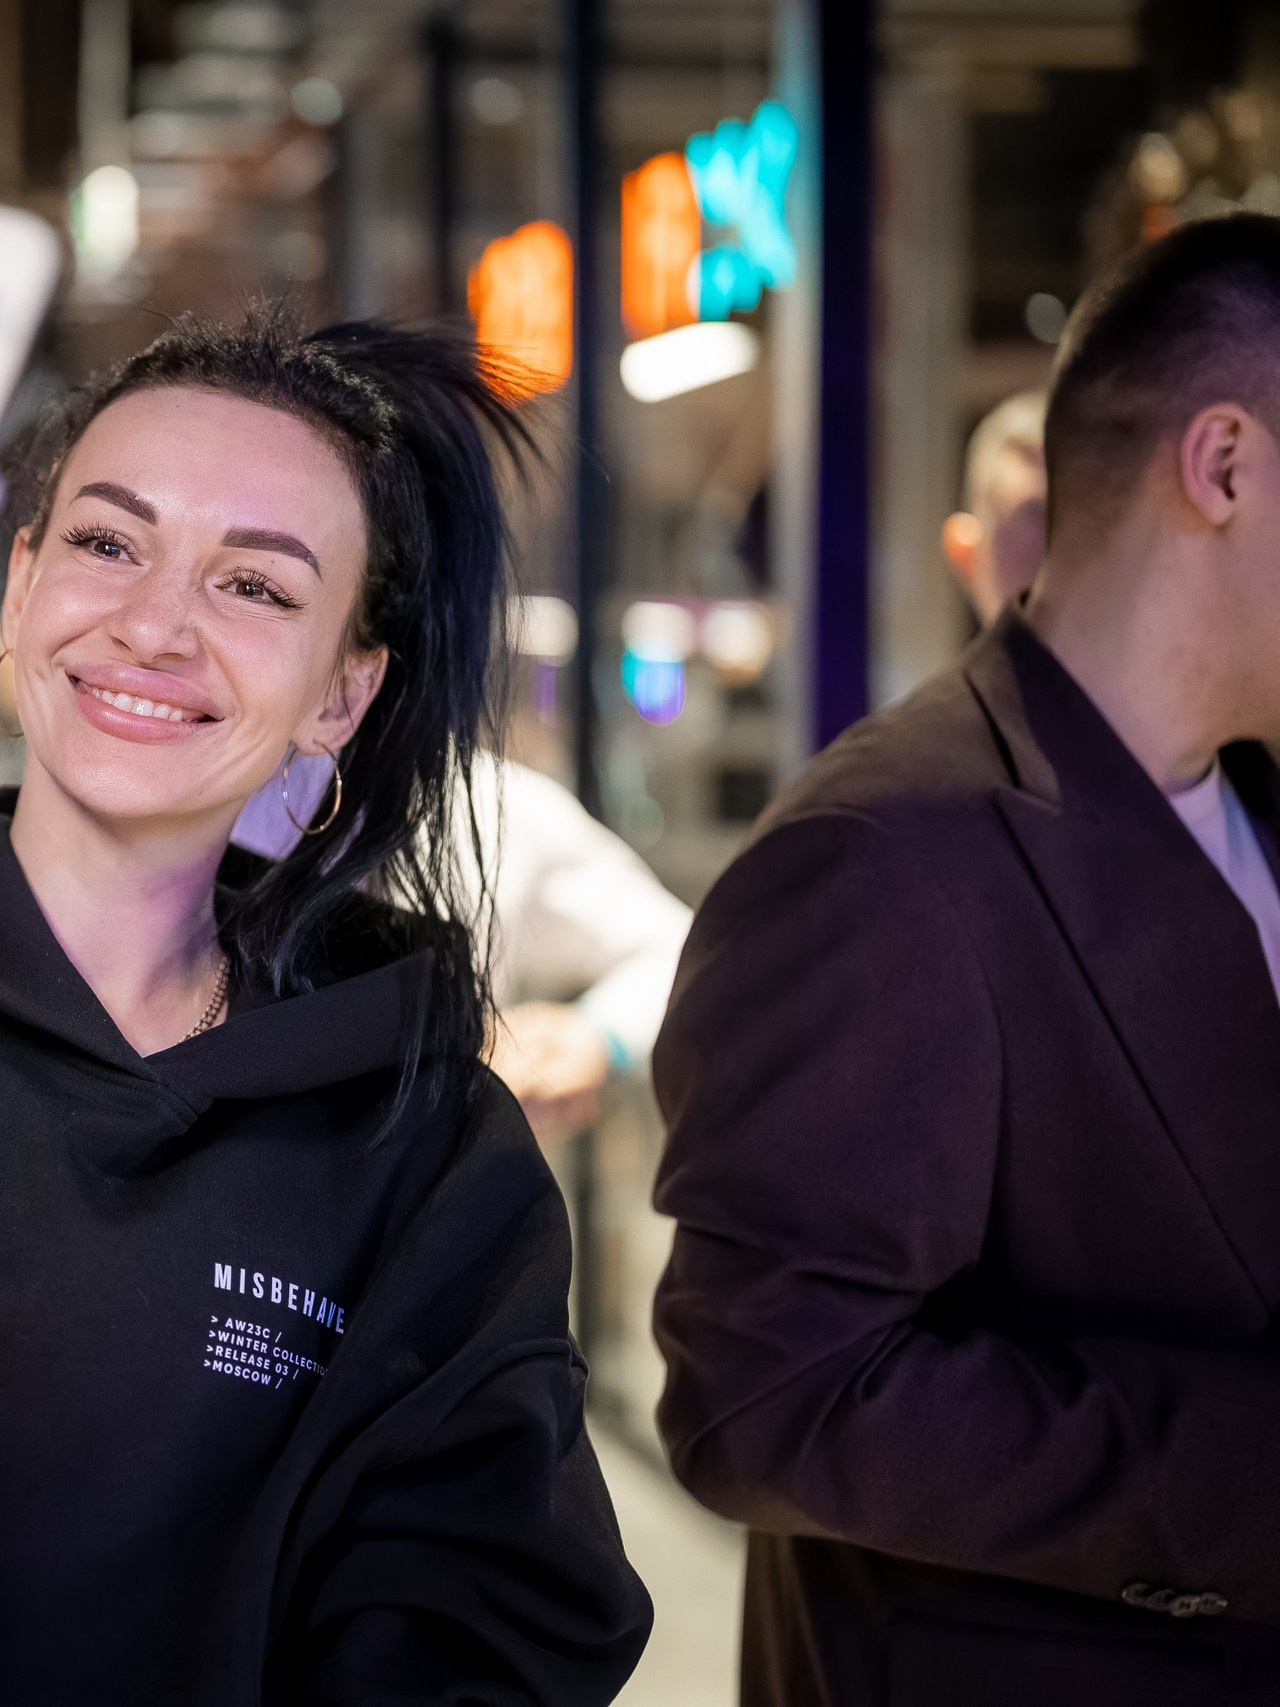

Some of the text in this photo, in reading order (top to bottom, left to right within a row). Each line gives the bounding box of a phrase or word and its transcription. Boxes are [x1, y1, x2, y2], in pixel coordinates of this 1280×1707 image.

[214, 1262, 345, 1335] MISBEHAVE
[225, 1317, 271, 1339] AW23C
[273, 1347, 328, 1377] COLLECTIO
[275, 1362, 289, 1376] 03
